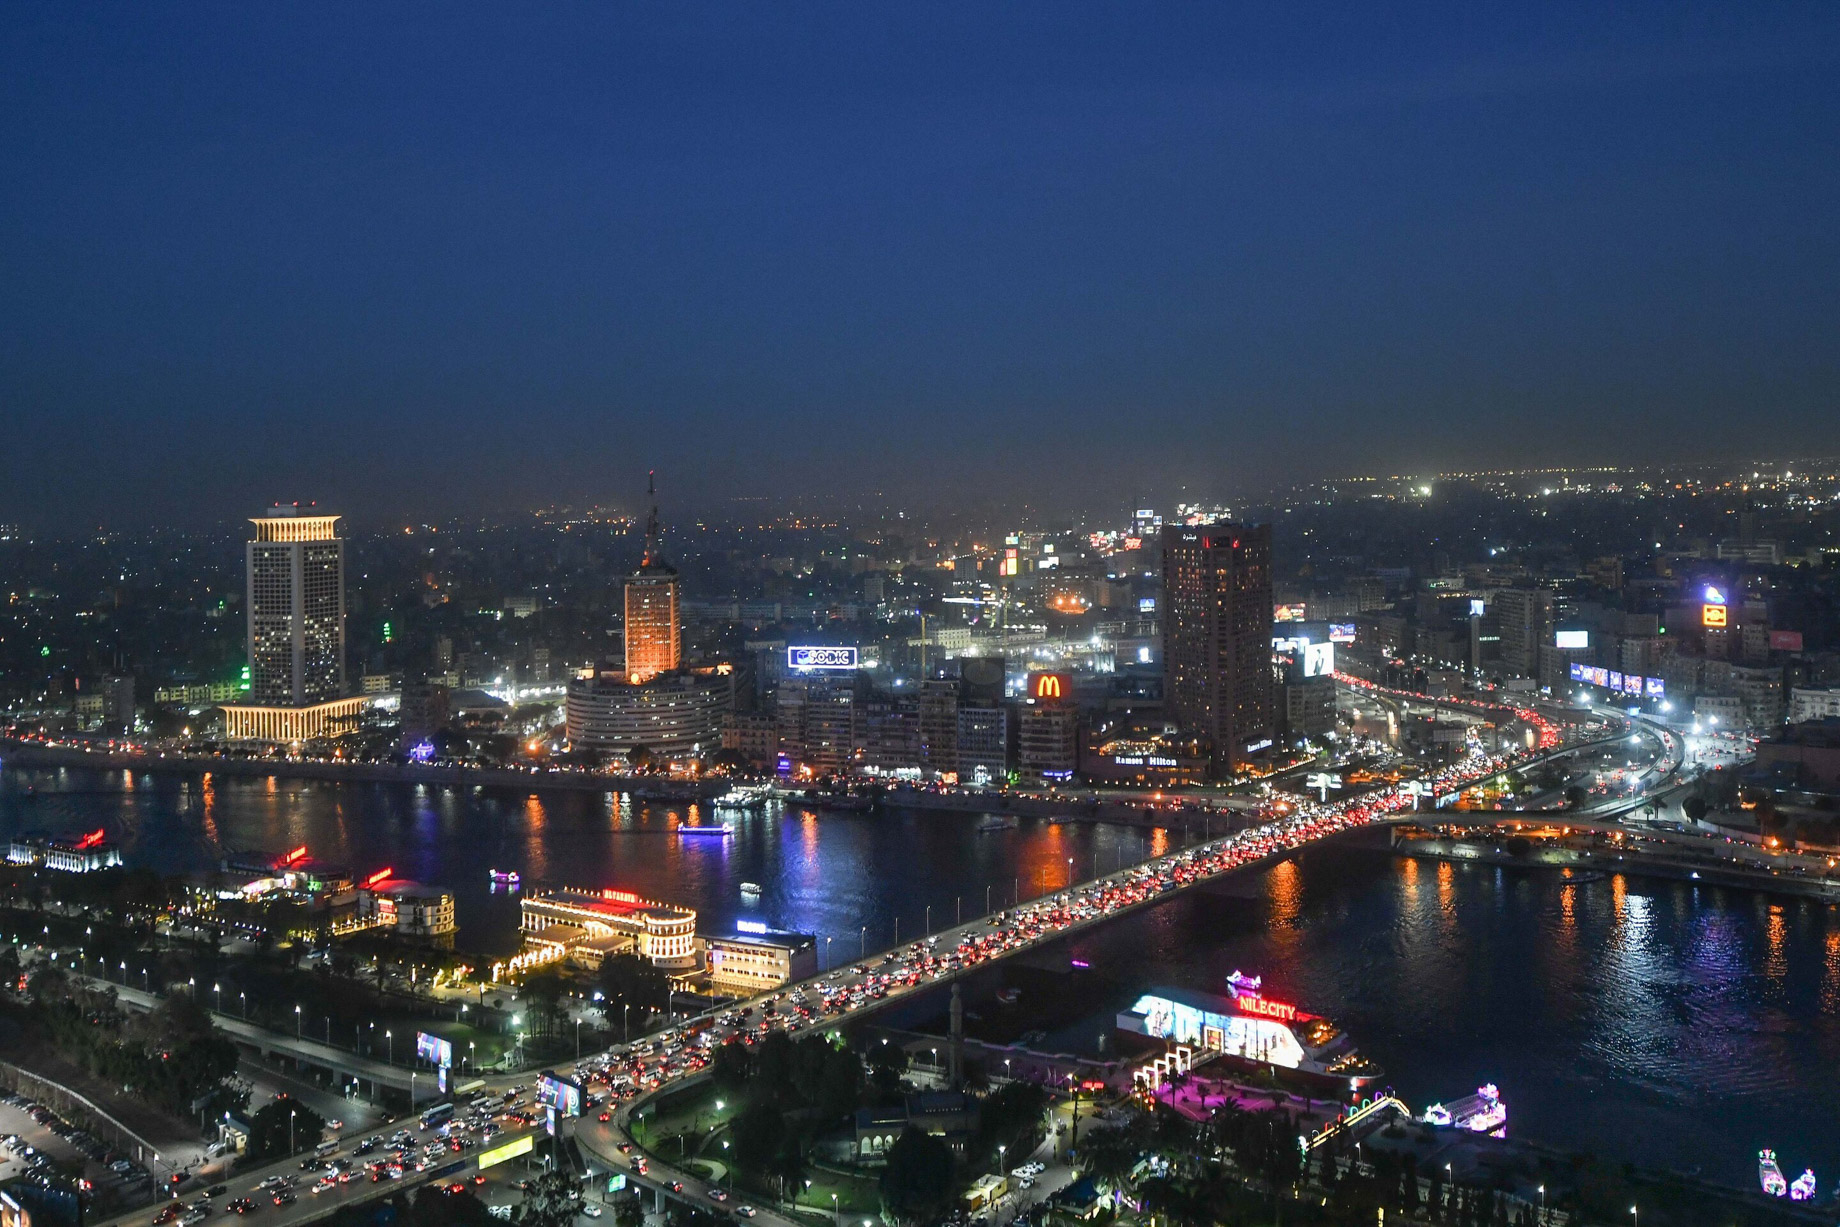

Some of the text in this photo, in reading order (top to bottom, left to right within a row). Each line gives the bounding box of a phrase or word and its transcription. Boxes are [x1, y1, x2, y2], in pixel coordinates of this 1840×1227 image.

[809, 650, 849, 664] SODIC
[1115, 756, 1177, 766] Ramses Hilton
